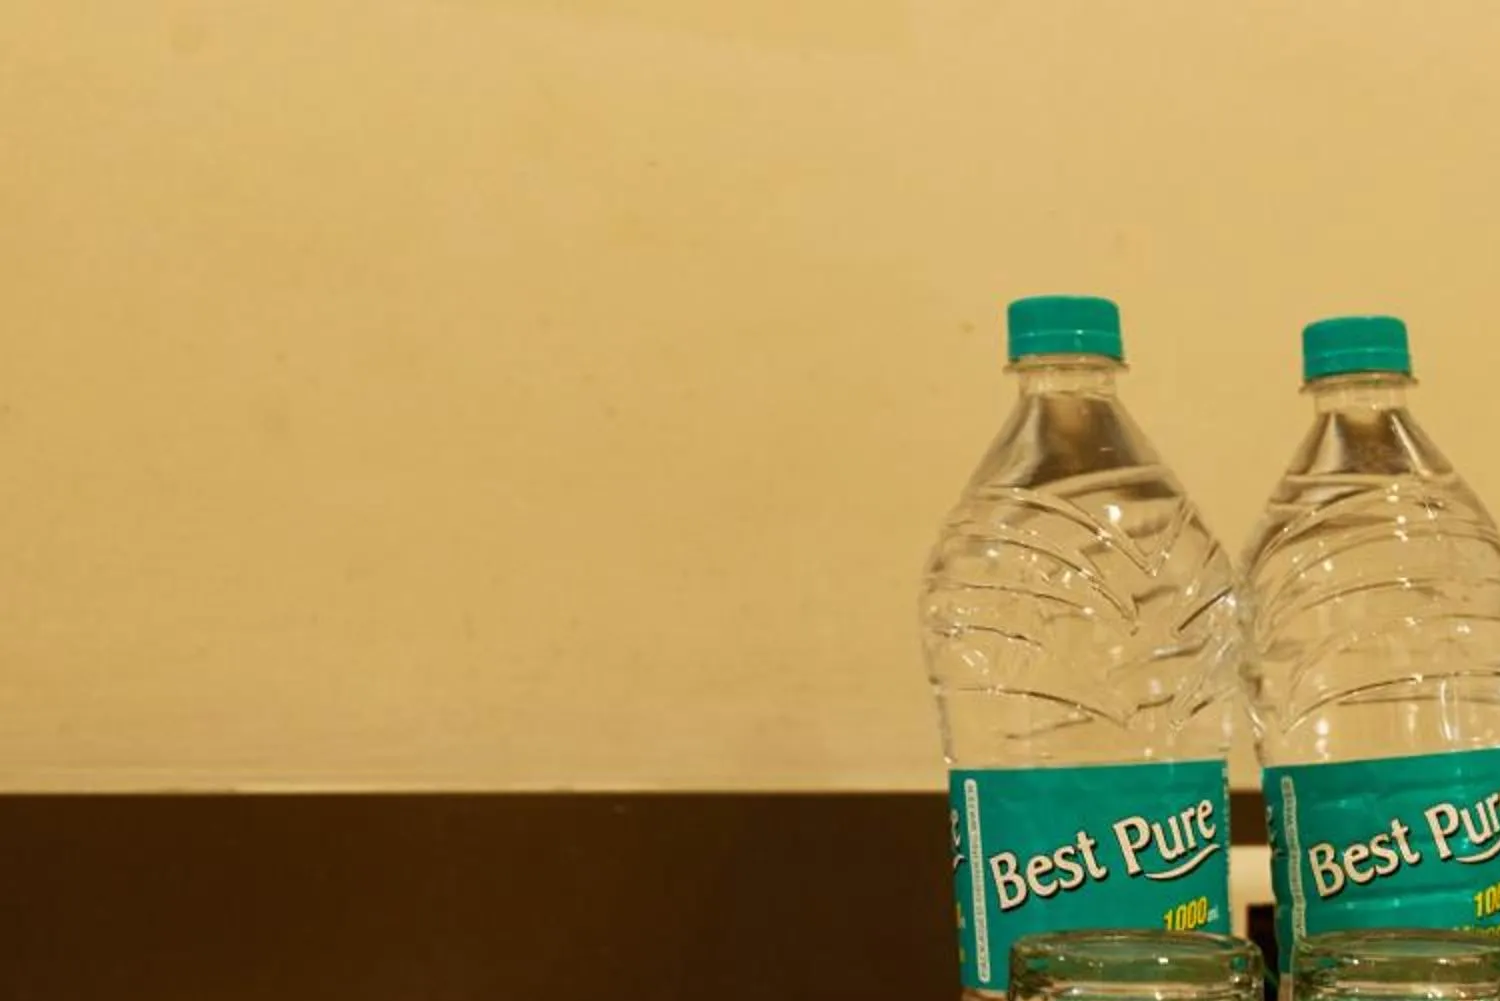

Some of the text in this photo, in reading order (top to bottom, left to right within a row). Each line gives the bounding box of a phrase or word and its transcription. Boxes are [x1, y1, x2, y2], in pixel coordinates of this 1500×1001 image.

[989, 830, 1108, 910] Best
[1112, 799, 1217, 876] Pure
[1308, 817, 1421, 897] Best
